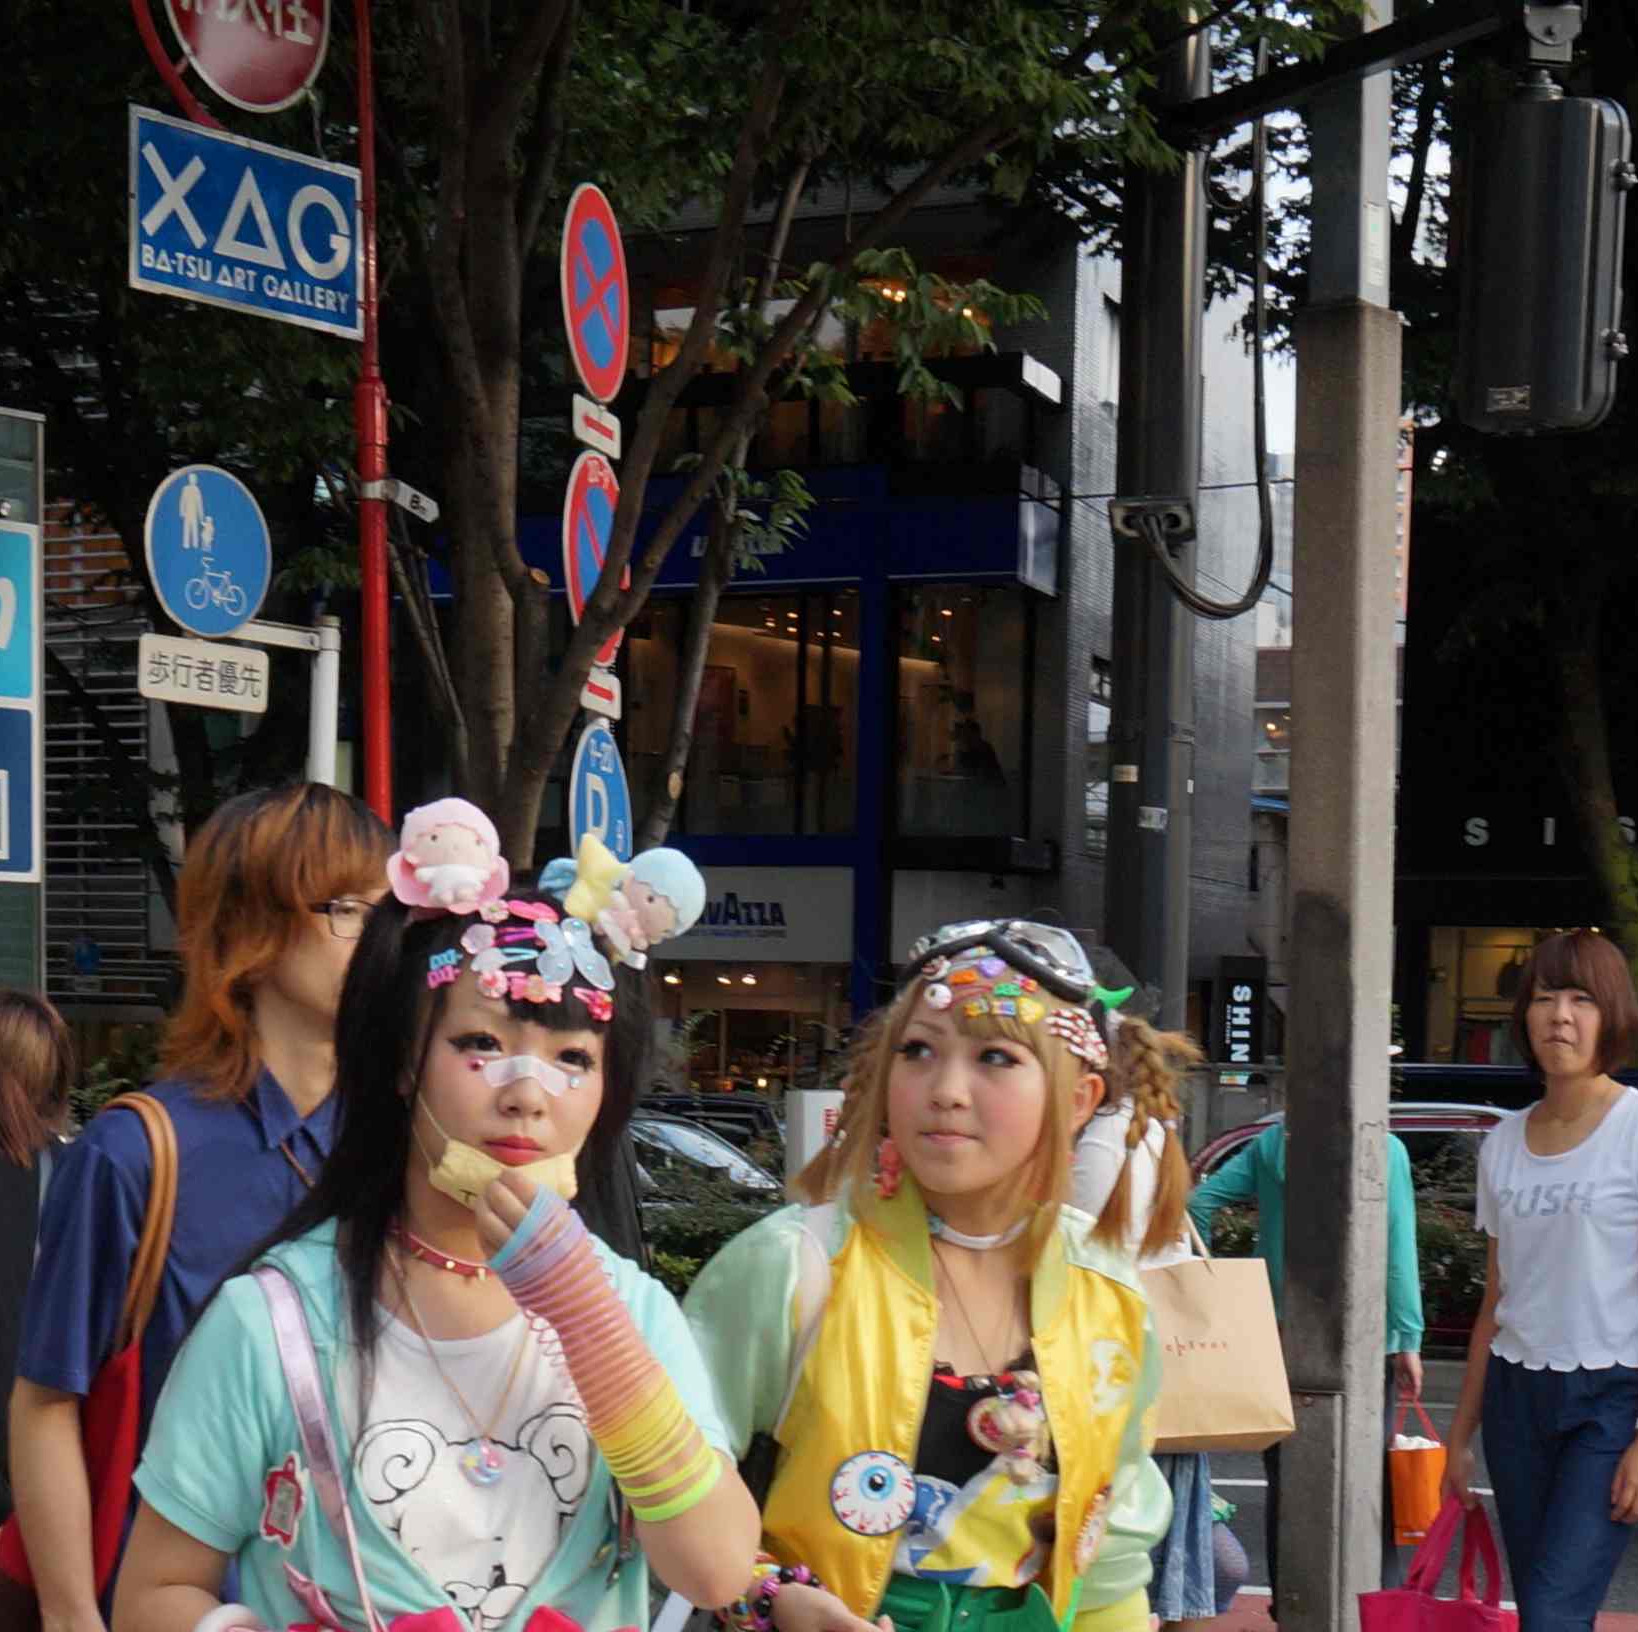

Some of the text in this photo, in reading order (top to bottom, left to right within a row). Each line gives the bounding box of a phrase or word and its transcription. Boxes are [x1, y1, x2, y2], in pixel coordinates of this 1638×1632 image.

[141, 243, 350, 315] BA-TSU ART GALLERY
[147, 650, 262, 699] 歩行者優先
[699, 892, 787, 927] VAZZA
[1499, 1181, 1597, 1219] PUSH
